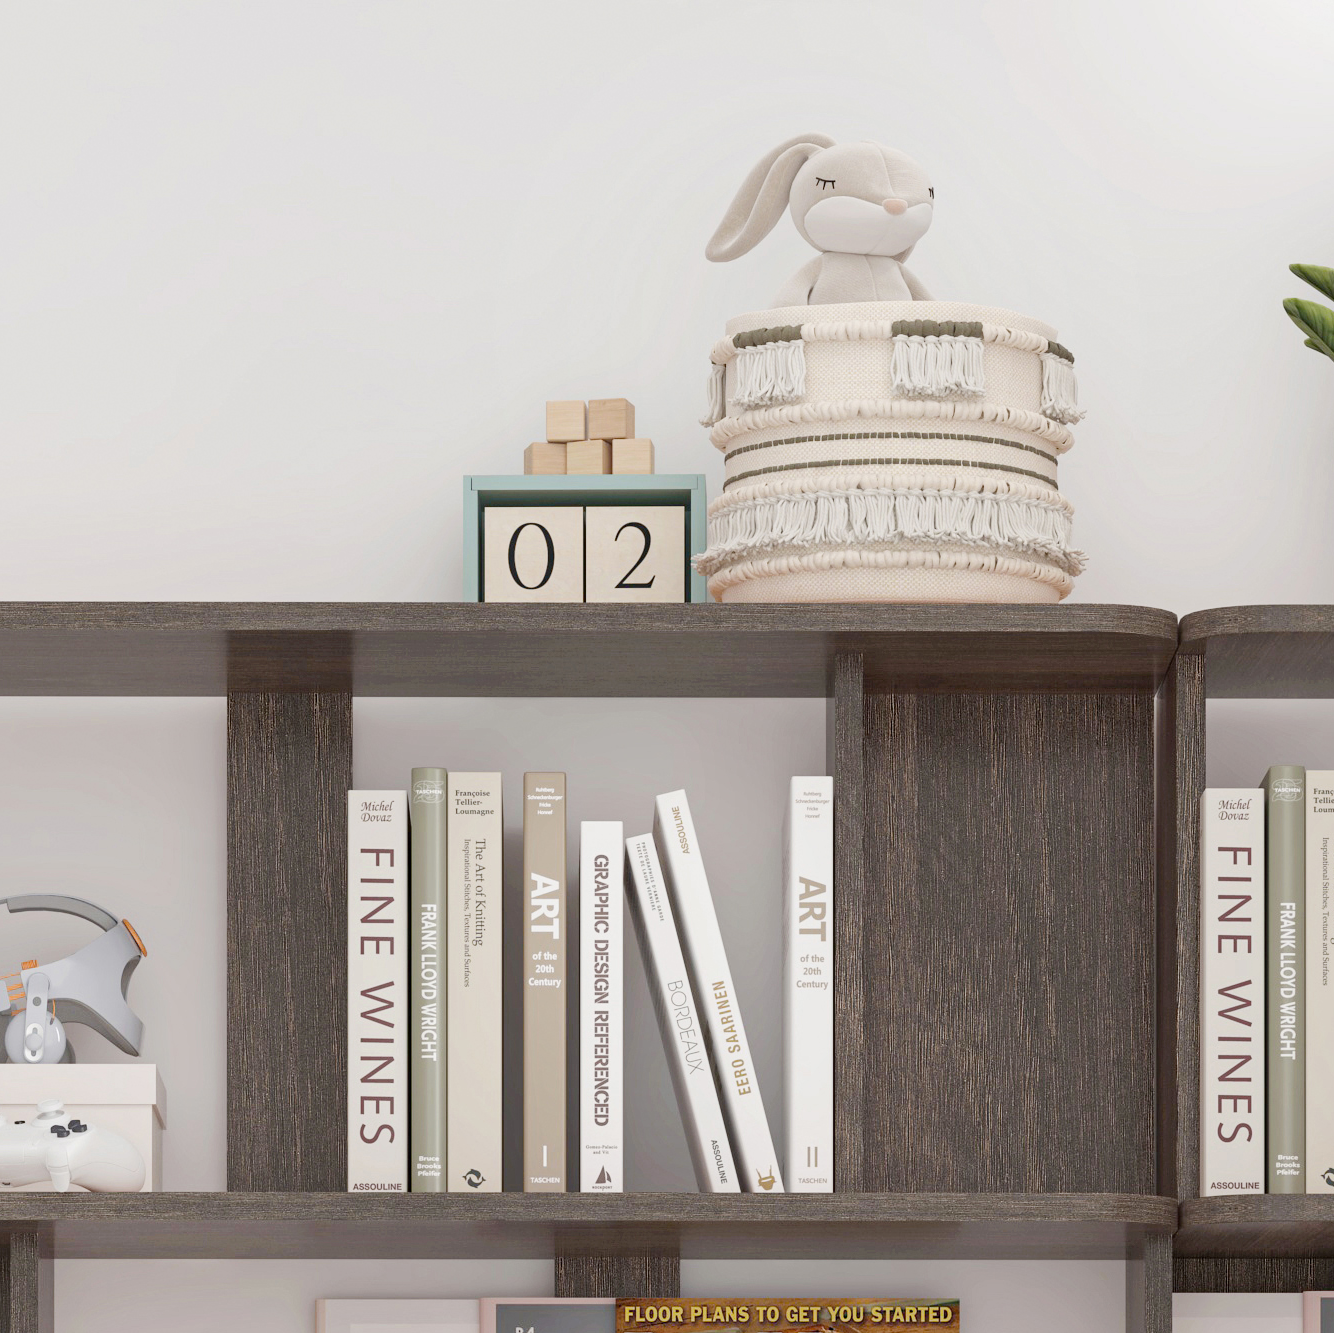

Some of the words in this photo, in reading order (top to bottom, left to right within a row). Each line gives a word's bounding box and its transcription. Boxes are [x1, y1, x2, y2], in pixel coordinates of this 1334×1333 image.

[613, 521, 655, 588] 2
[359, 800, 393, 812] Michel
[454, 789, 490, 797] Françoise
[454, 807, 494, 815] Loumagne
[360, 812, 392, 822] Dovaz
[670, 804, 690, 854] ASSOULINE
[474, 838, 485, 860] The
[474, 864, 485, 881] Art
[359, 847, 394, 955] FINE
[474, 884, 485, 895] of
[530, 871, 559, 939] ART
[592, 853, 609, 933] GRAPHIC
[797, 875, 827, 941] ART
[1216, 845, 1252, 953] FINE
[420, 903, 436, 950] FRANK
[472, 896, 485, 945] Knitting
[1279, 901, 1295, 948] FRANK
[420, 952, 436, 999] LLOYD
[531, 951, 543, 960] of
[544, 951, 557, 960] the
[534, 963, 554, 973] 20th
[592, 938, 609, 1004] DESIGN
[802, 966, 821, 976] 20th
[1279, 951, 1295, 998] LLOYD
[527, 976, 561, 987] Century
[795, 979, 828, 990] Century
[420, 1003, 436, 1060] WRIGHT
[665, 978, 704, 1075] BORDEAUX
[712, 980, 741, 1053] SAARINEN
[1279, 1002, 1295, 1059] WRIGHT
[359, 979, 394, 1144] WINES
[592, 1009, 609, 1126] REFERENCED
[731, 1056, 752, 1096] EERO
[1216, 978, 1252, 1142] WINES
[416, 1169, 440, 1177] Pfeifer
[417, 1154, 439, 1162] Bruce
[710, 1138, 728, 1183] ASSOULINE
[352, 1181, 402, 1191] ASSOULINE
[622, 1305, 683, 1322] FLOOR
[689, 1305, 749, 1322] PLANS
[755, 1305, 780, 1322] TO
[784, 1305, 821, 1322] GET
[825, 1305, 864, 1322] YOU
[870, 1305, 952, 1323] STARTED
